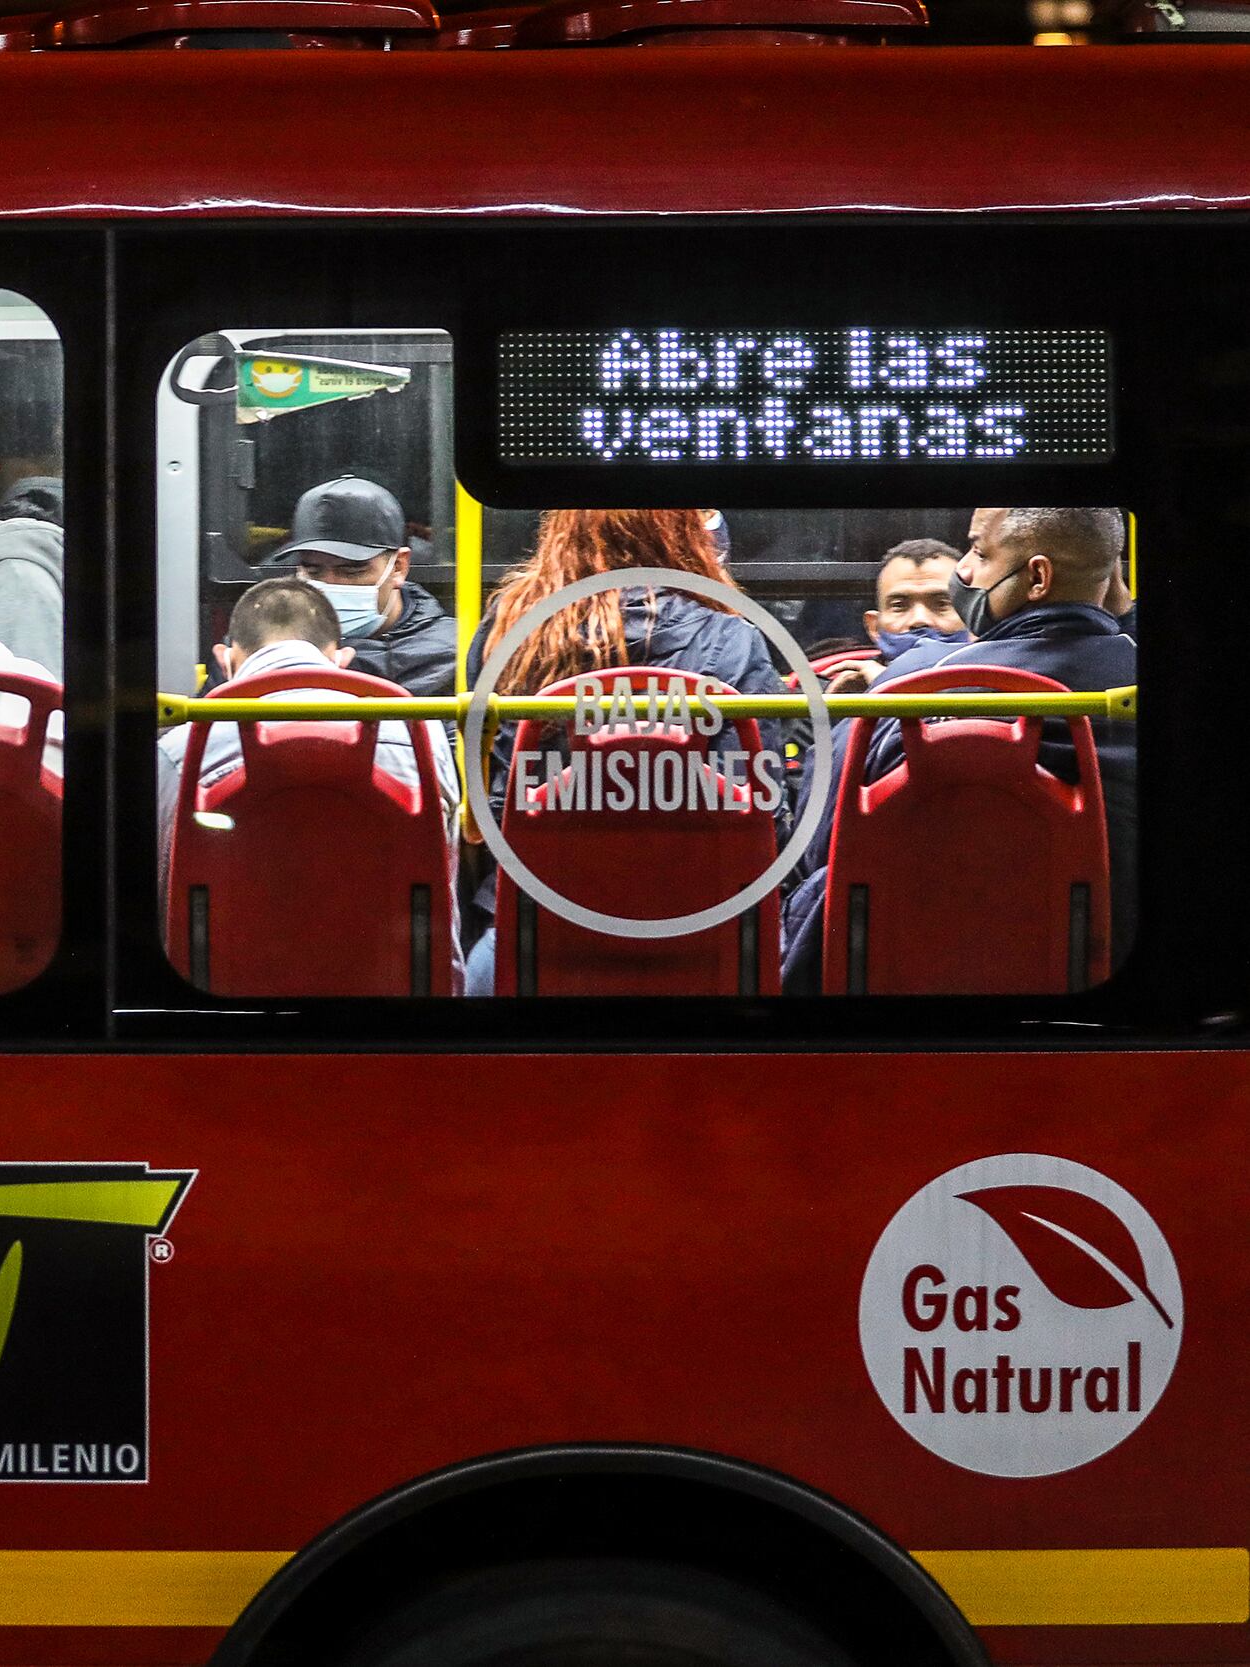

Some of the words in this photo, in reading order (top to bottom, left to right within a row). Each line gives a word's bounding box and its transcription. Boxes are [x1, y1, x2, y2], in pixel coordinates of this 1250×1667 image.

[601, 330, 815, 389] Abre
[849, 328, 987, 388] las
[581, 396, 1024, 460] ventanas
[573, 676, 724, 737] BAJAS
[514, 749, 783, 812] EMISIONES
[901, 1263, 1022, 1332] Gas
[902, 1340, 1142, 1414] Natural
